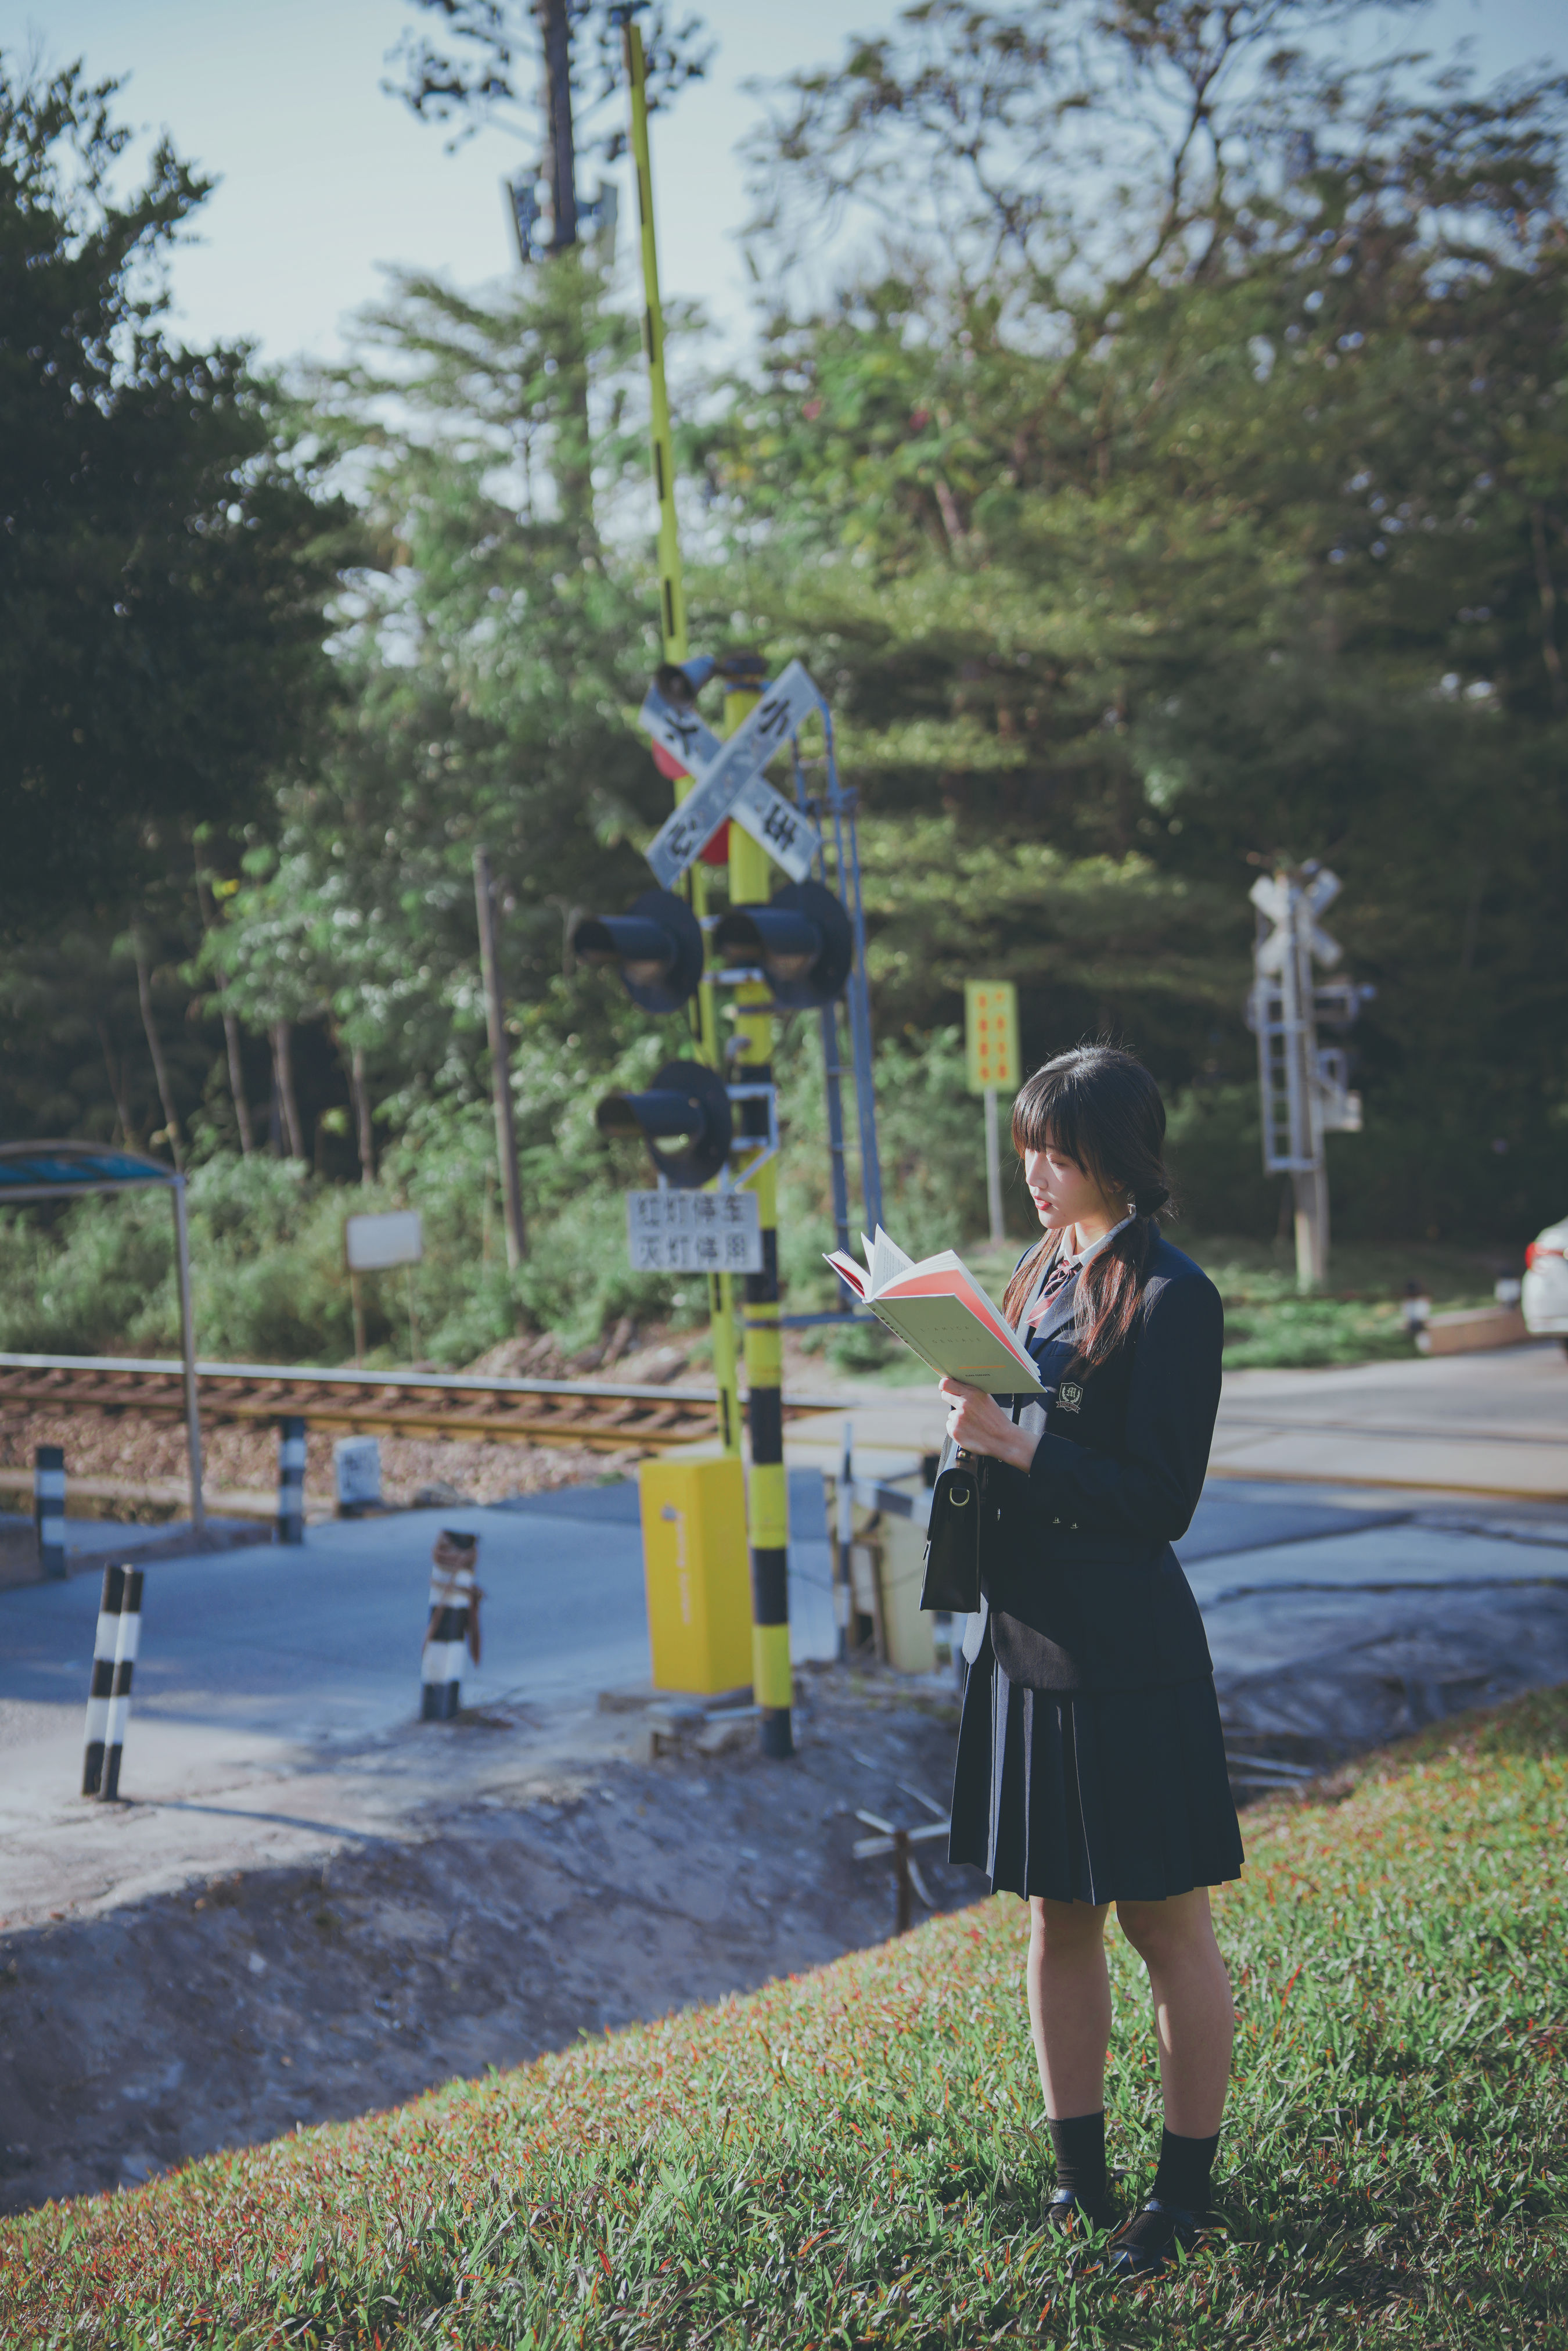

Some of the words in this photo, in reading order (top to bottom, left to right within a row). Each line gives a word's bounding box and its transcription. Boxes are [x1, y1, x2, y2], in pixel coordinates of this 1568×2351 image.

[637, 1194, 744, 1227] 红灯停车
[638, 1232, 747, 1266] 灭灯停用
[1066, 1387, 1077, 1398] M
